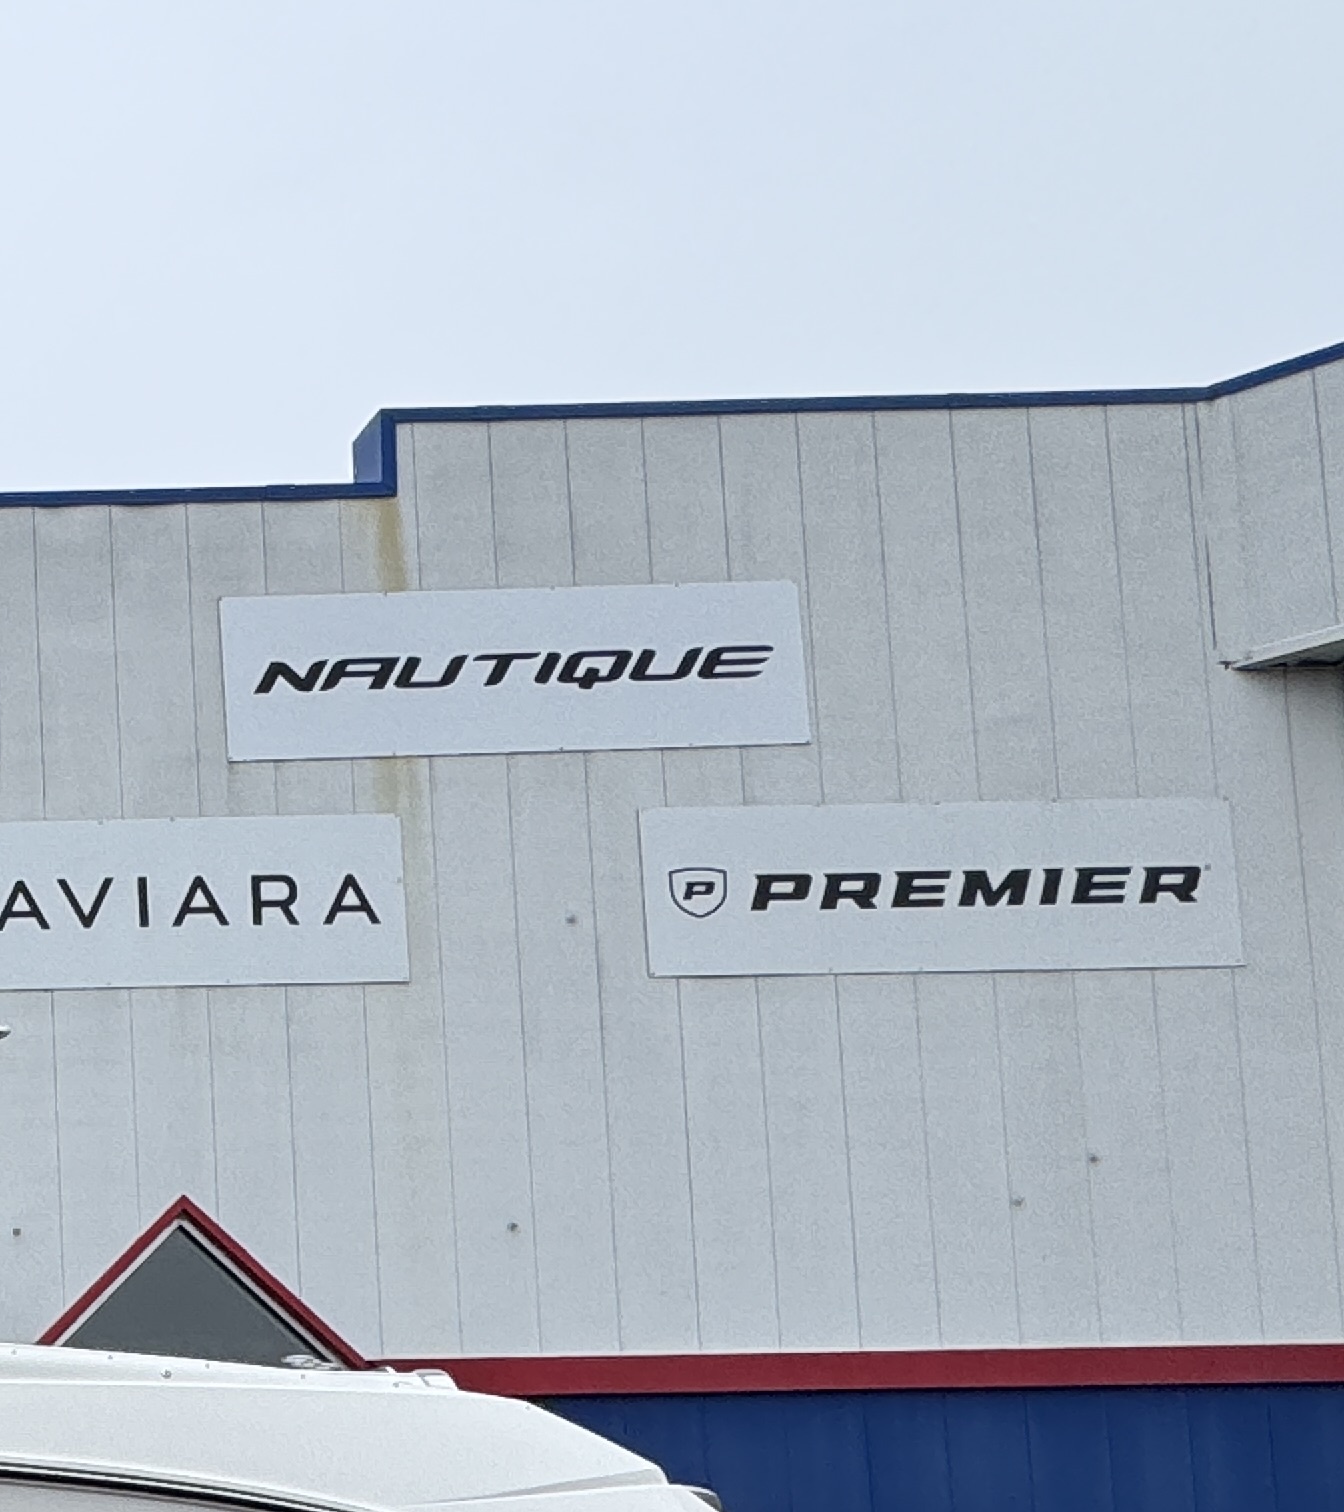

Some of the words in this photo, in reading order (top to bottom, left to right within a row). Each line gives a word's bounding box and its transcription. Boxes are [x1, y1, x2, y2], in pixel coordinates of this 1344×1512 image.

[254, 644, 775, 695] NAUTIQUE
[682, 880, 716, 901] P
[750, 865, 1203, 912] PREMIER
